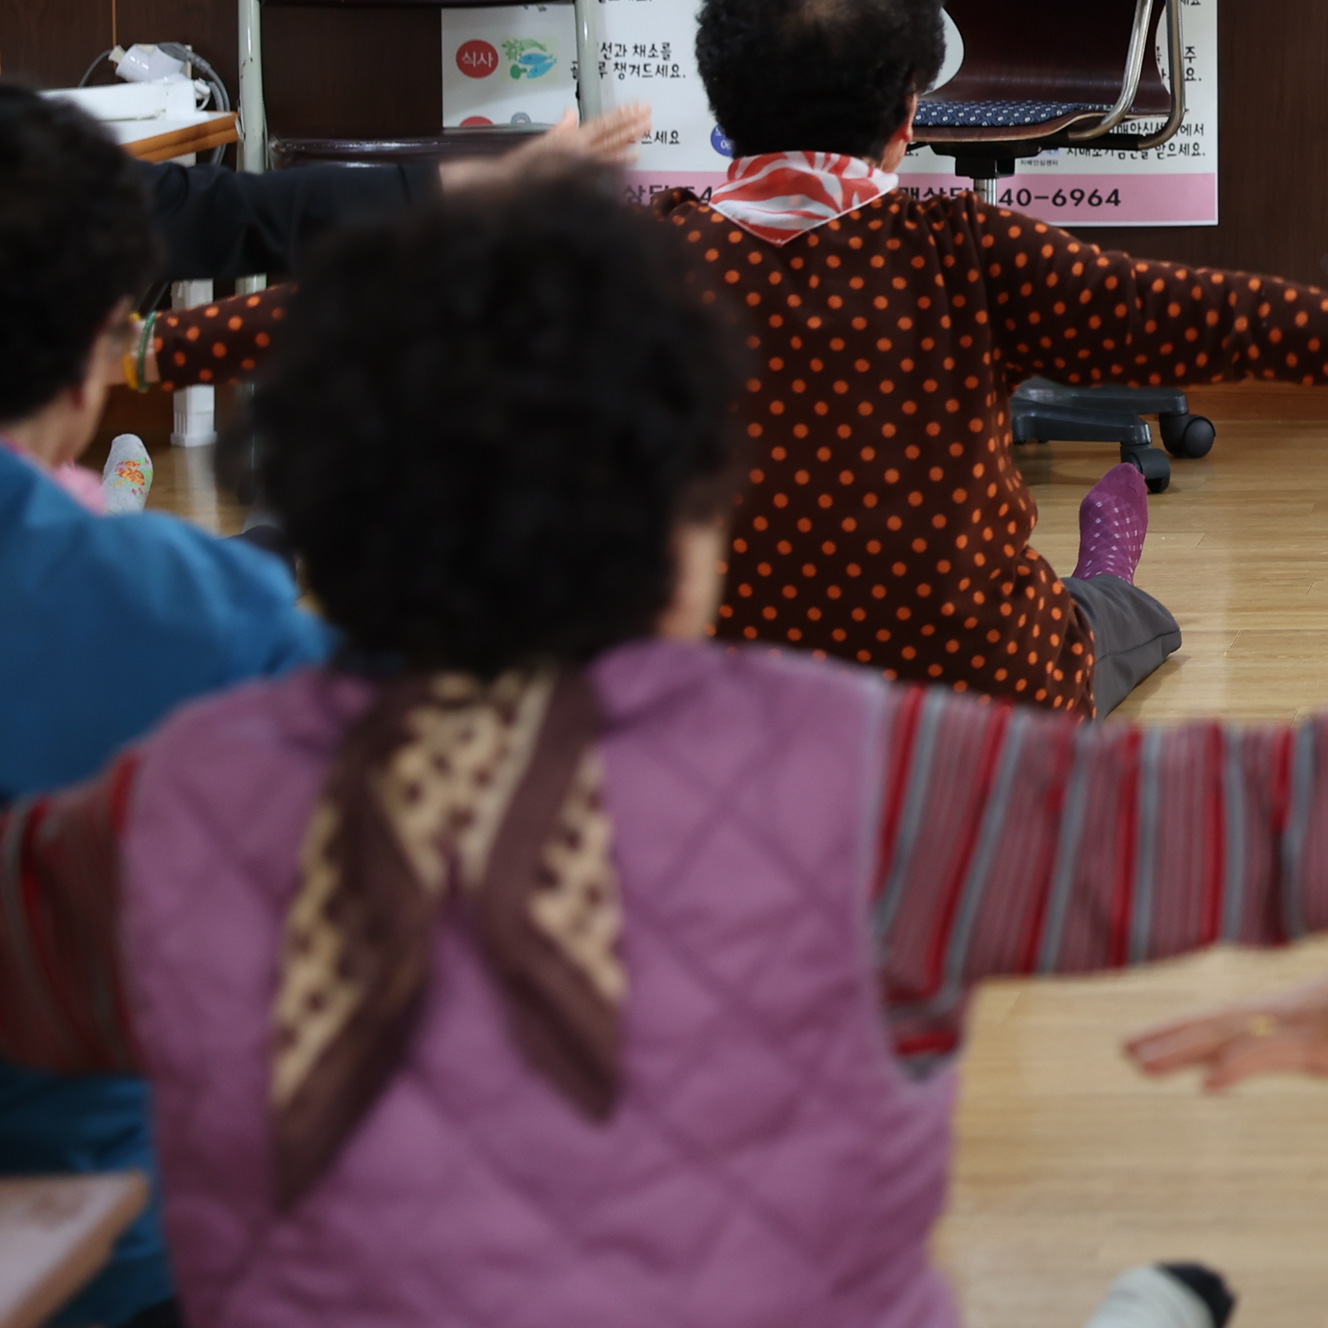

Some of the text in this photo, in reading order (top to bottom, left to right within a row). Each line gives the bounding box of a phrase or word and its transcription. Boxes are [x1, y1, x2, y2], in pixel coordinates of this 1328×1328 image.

[461, 51, 493, 69] 식사
[632, 42, 673, 62] 채소를
[612, 61, 686, 81] 챙겨드세요.
[998, 187, 1122, 208] 40-6964
